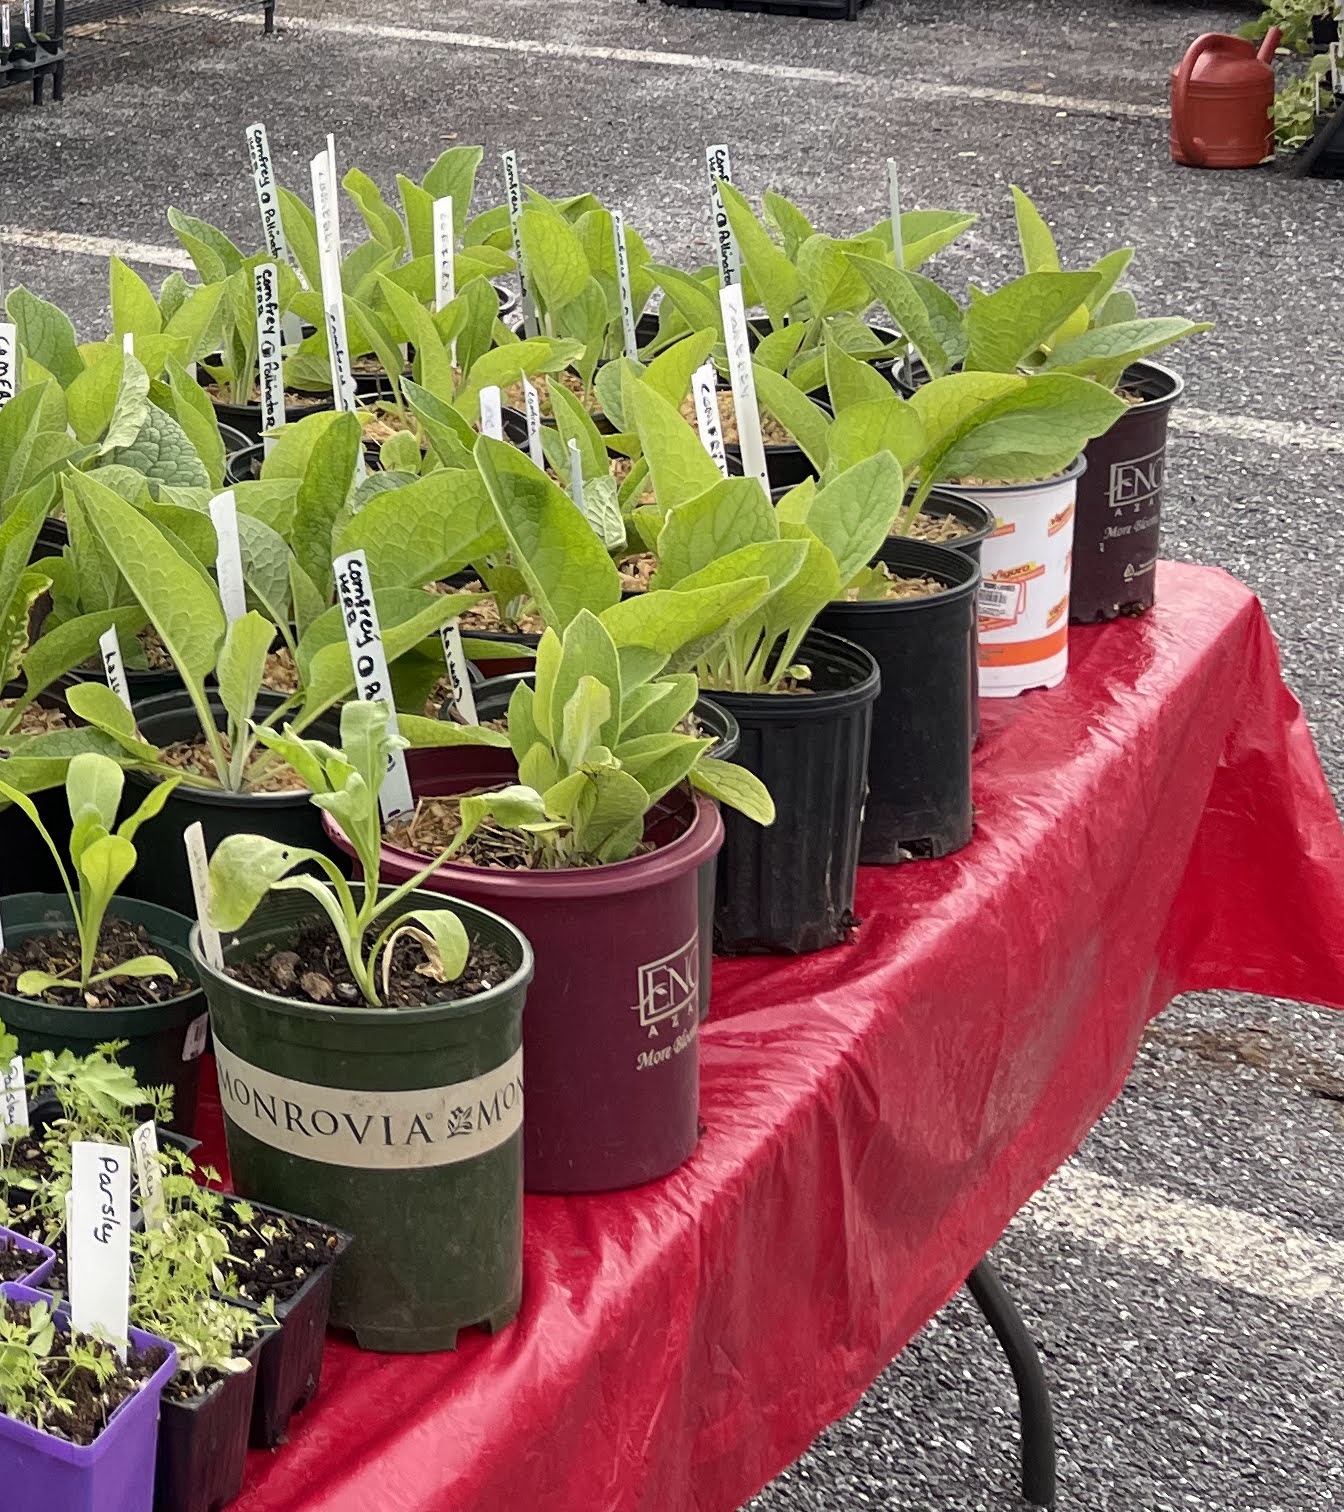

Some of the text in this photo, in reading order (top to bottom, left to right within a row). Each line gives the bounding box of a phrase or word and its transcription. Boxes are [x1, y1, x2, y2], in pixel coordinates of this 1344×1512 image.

[991, 564, 1030, 580] Vigoro
[217, 1063, 435, 1146] MONROVIA
[93, 1156, 119, 1245] Parsley
